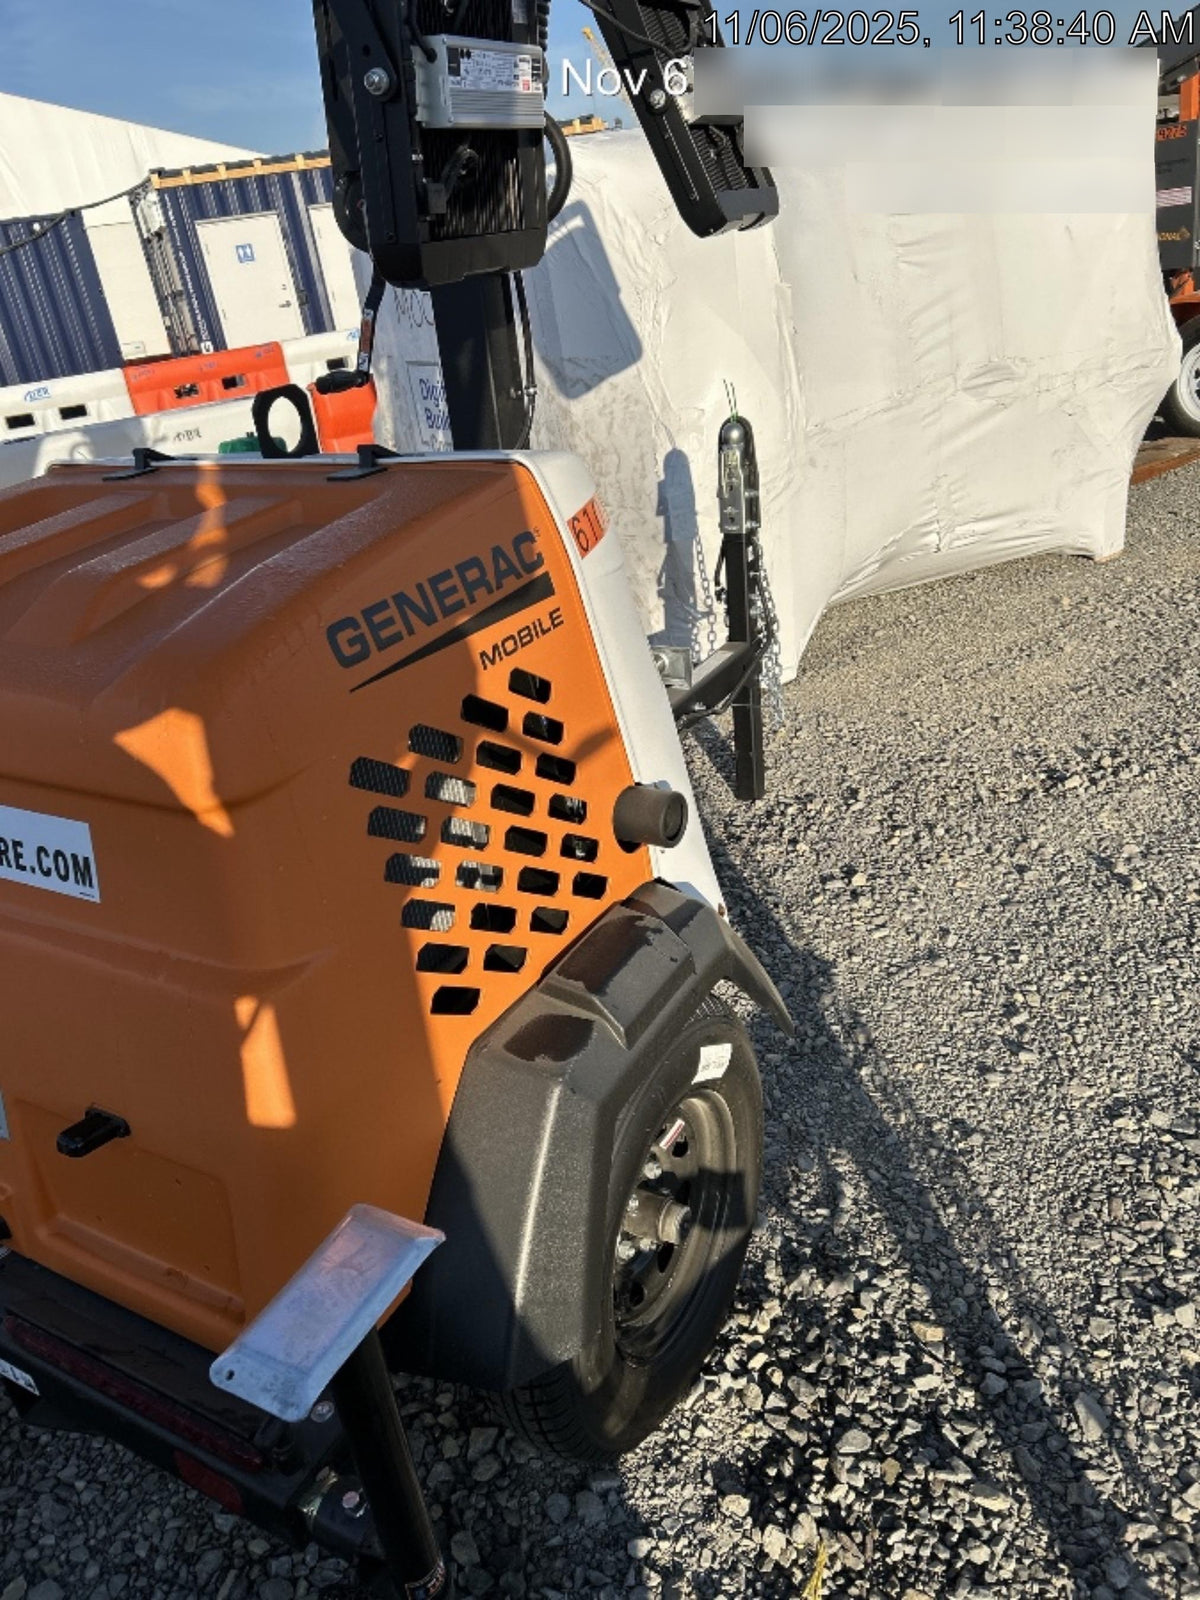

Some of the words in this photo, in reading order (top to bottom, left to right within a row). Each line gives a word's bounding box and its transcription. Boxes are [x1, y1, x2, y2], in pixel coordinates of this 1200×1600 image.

[326, 530, 545, 669] GENERAC
[479, 606, 564, 670] MOBILE
[0, 836, 95, 889] RE.COM
